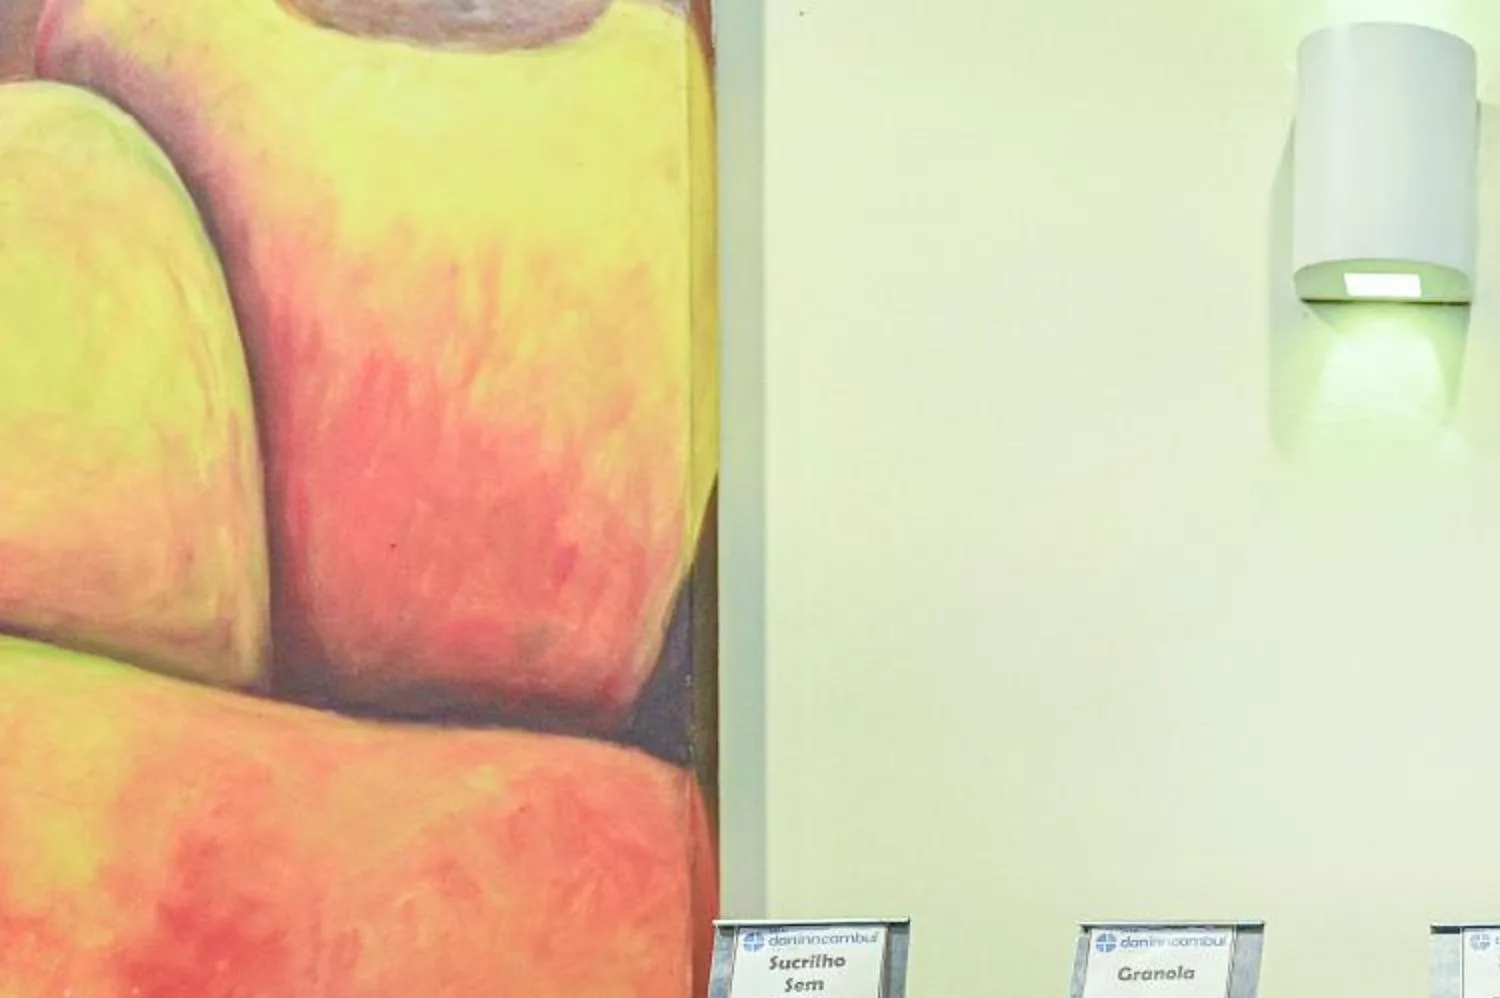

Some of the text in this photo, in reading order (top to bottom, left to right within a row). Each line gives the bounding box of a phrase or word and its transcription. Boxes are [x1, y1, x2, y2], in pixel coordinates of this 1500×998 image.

[769, 954, 846, 970] Sucrilho
[1117, 965, 1196, 981] Granola
[785, 978, 825, 992] Sem
